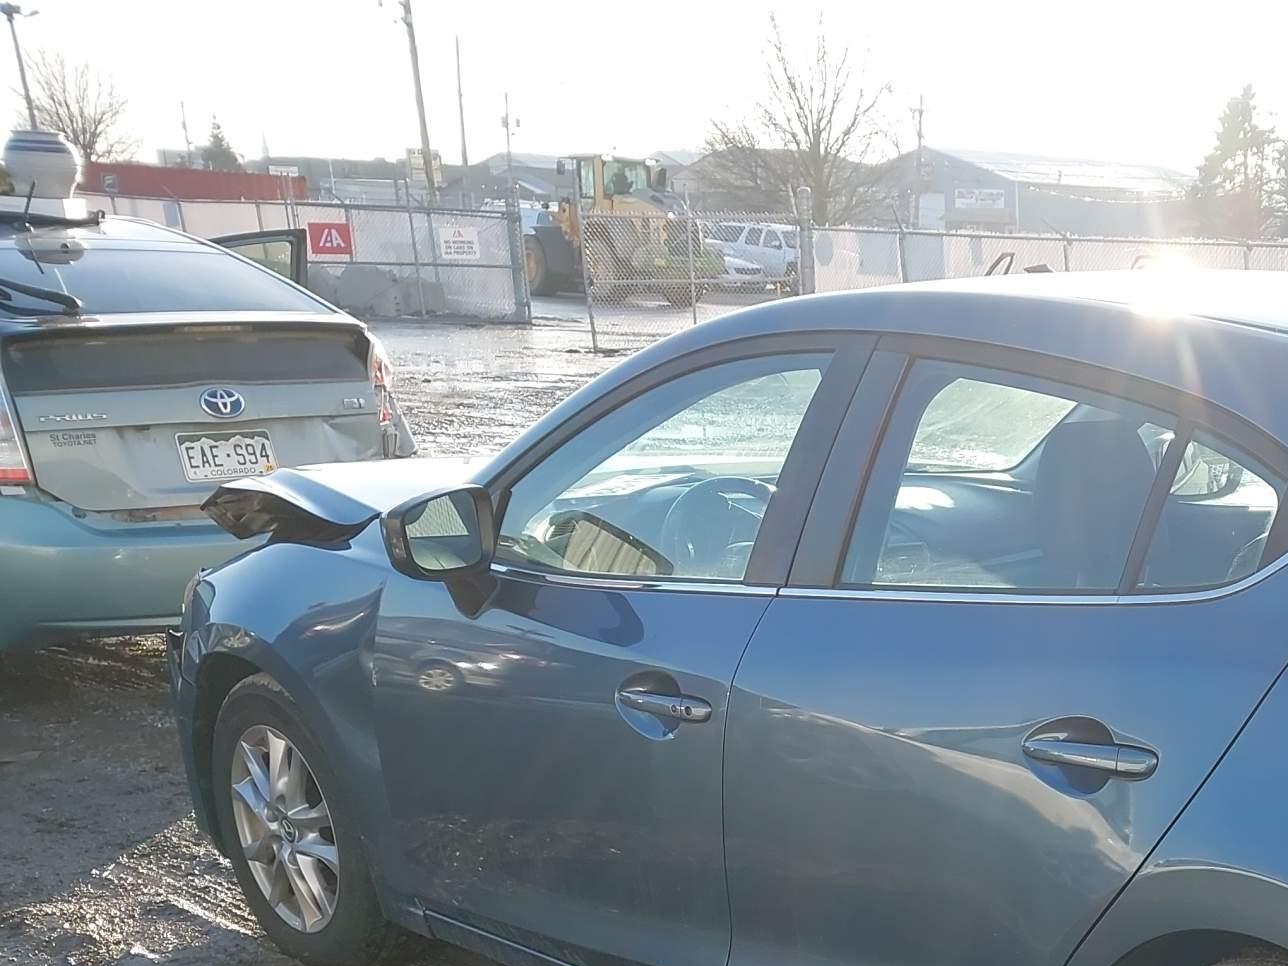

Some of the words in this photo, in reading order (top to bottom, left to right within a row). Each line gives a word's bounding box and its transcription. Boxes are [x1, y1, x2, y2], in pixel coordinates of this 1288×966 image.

[39, 412, 107, 421] PRIUS
[49, 433, 60, 442] St
[210, 466, 257, 477] COLORADO
